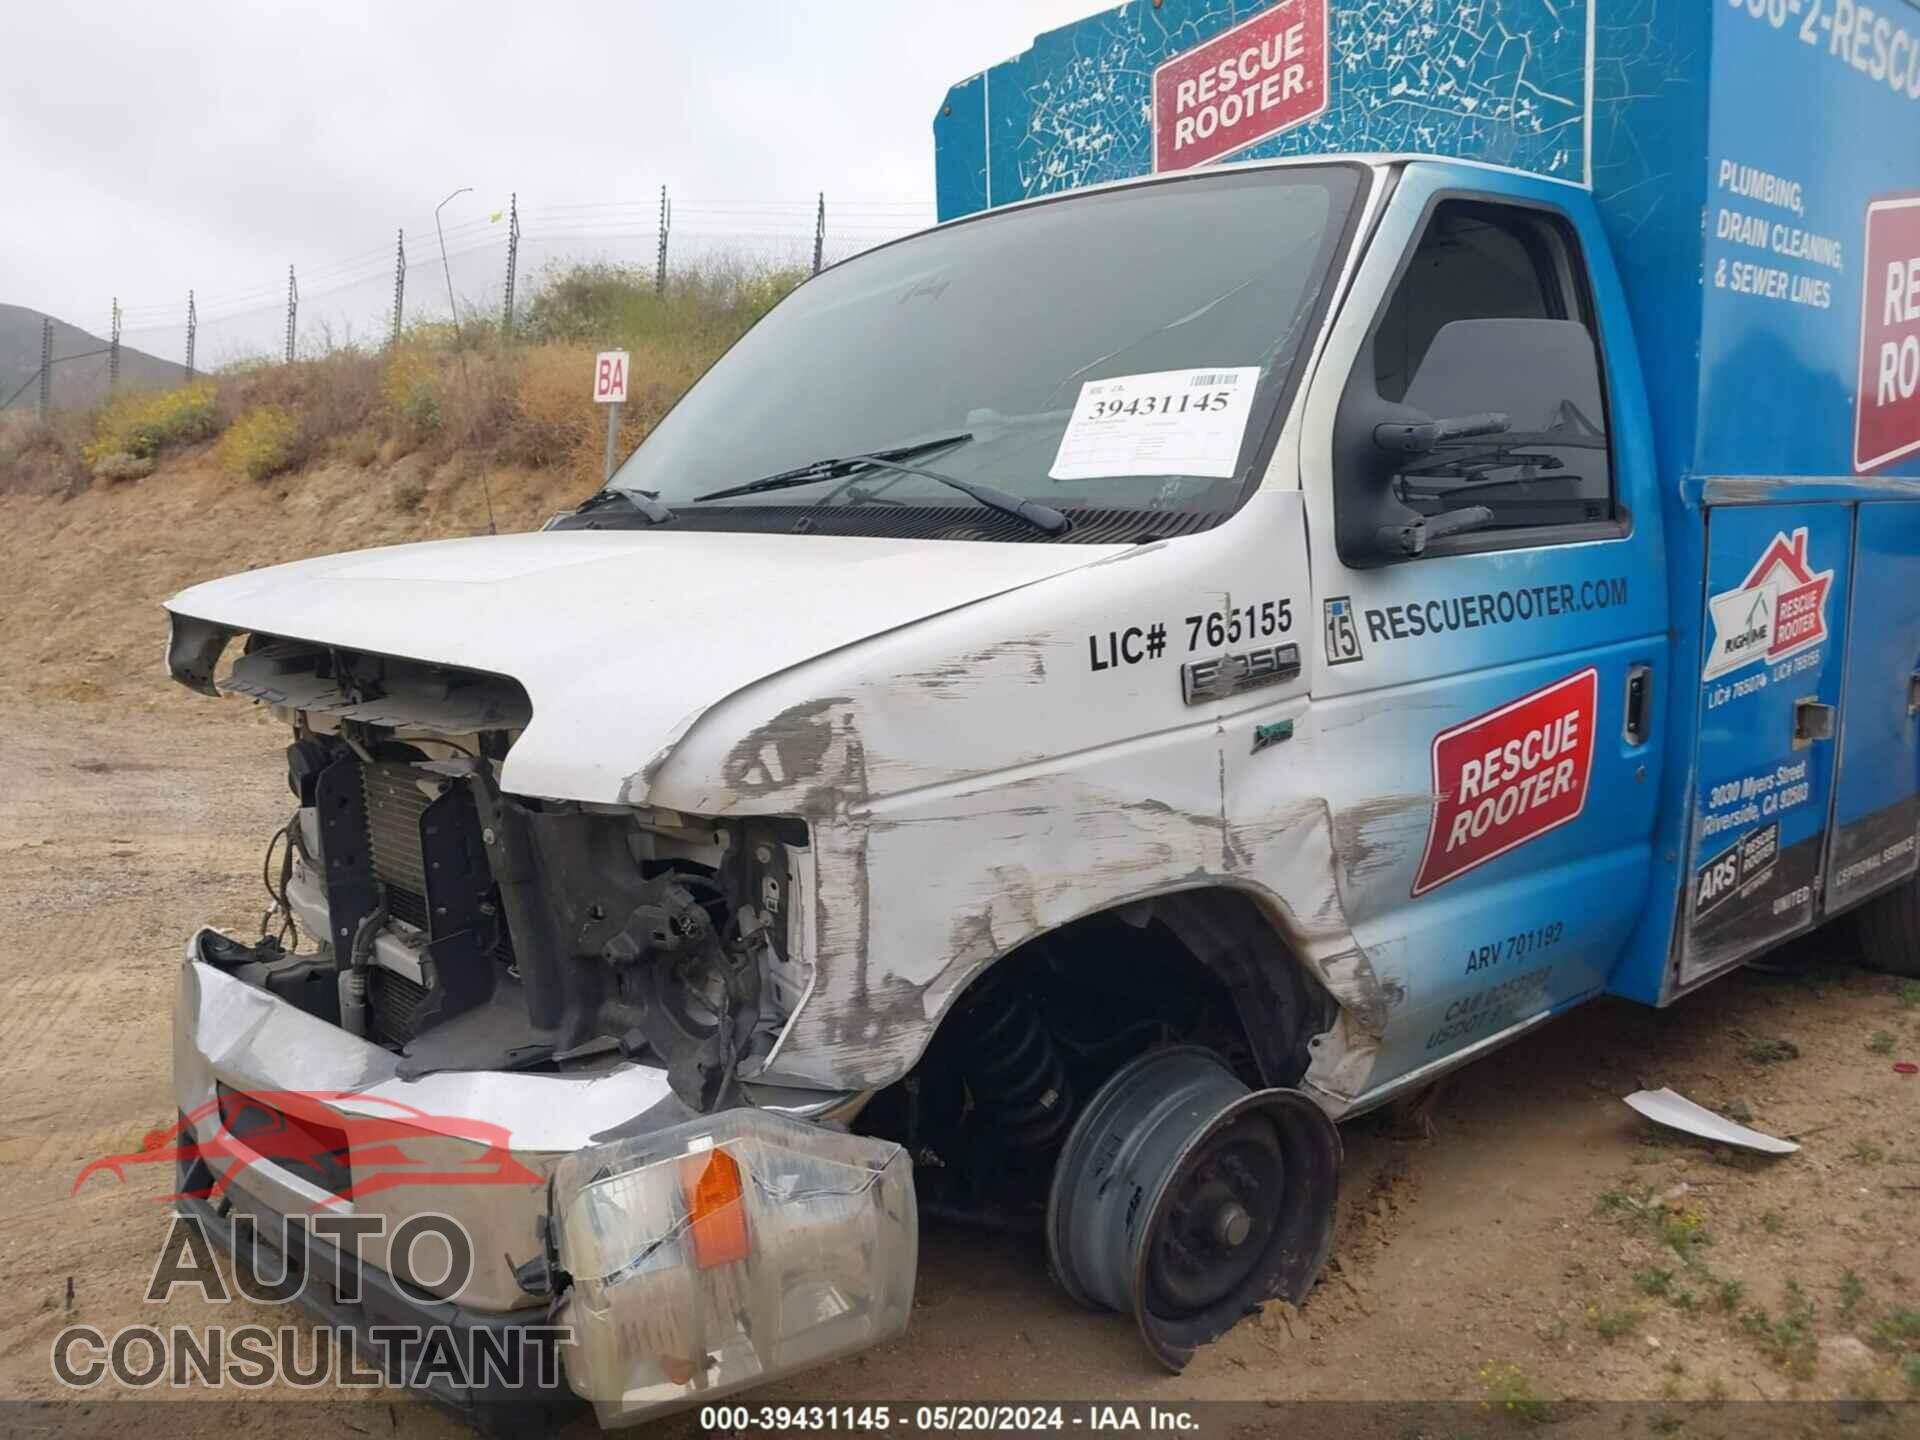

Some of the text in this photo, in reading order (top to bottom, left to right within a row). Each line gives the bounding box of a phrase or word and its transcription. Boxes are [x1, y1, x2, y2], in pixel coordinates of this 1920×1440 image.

[1177, 22, 1304, 114] RESCUE
[1719, 159, 1804, 217] PLUMBING,
[1717, 209, 1843, 273] DRAIN CLEANING,
[1714, 258, 1830, 309] & SEWER LINES
[598, 359, 623, 395] BA
[1088, 392, 1231, 419] 39431145
[1365, 579, 1628, 643] RESCUEROOTER.COM
[1780, 590, 1817, 619] RESCUE
[1089, 598, 1292, 671] LIC# 765155
[1329, 616, 1356, 657] 15
[1778, 612, 1816, 644] ROOTER
[1459, 710, 1579, 804] RESCUE
[1776, 760, 1806, 786] Street
[1763, 793, 1778, 815] CA
[1743, 840, 1776, 873] ROOTER
[1744, 824, 1776, 855] RESCUE
[1697, 854, 1736, 907] ARS
[1465, 920, 1563, 975] ARV 701192
